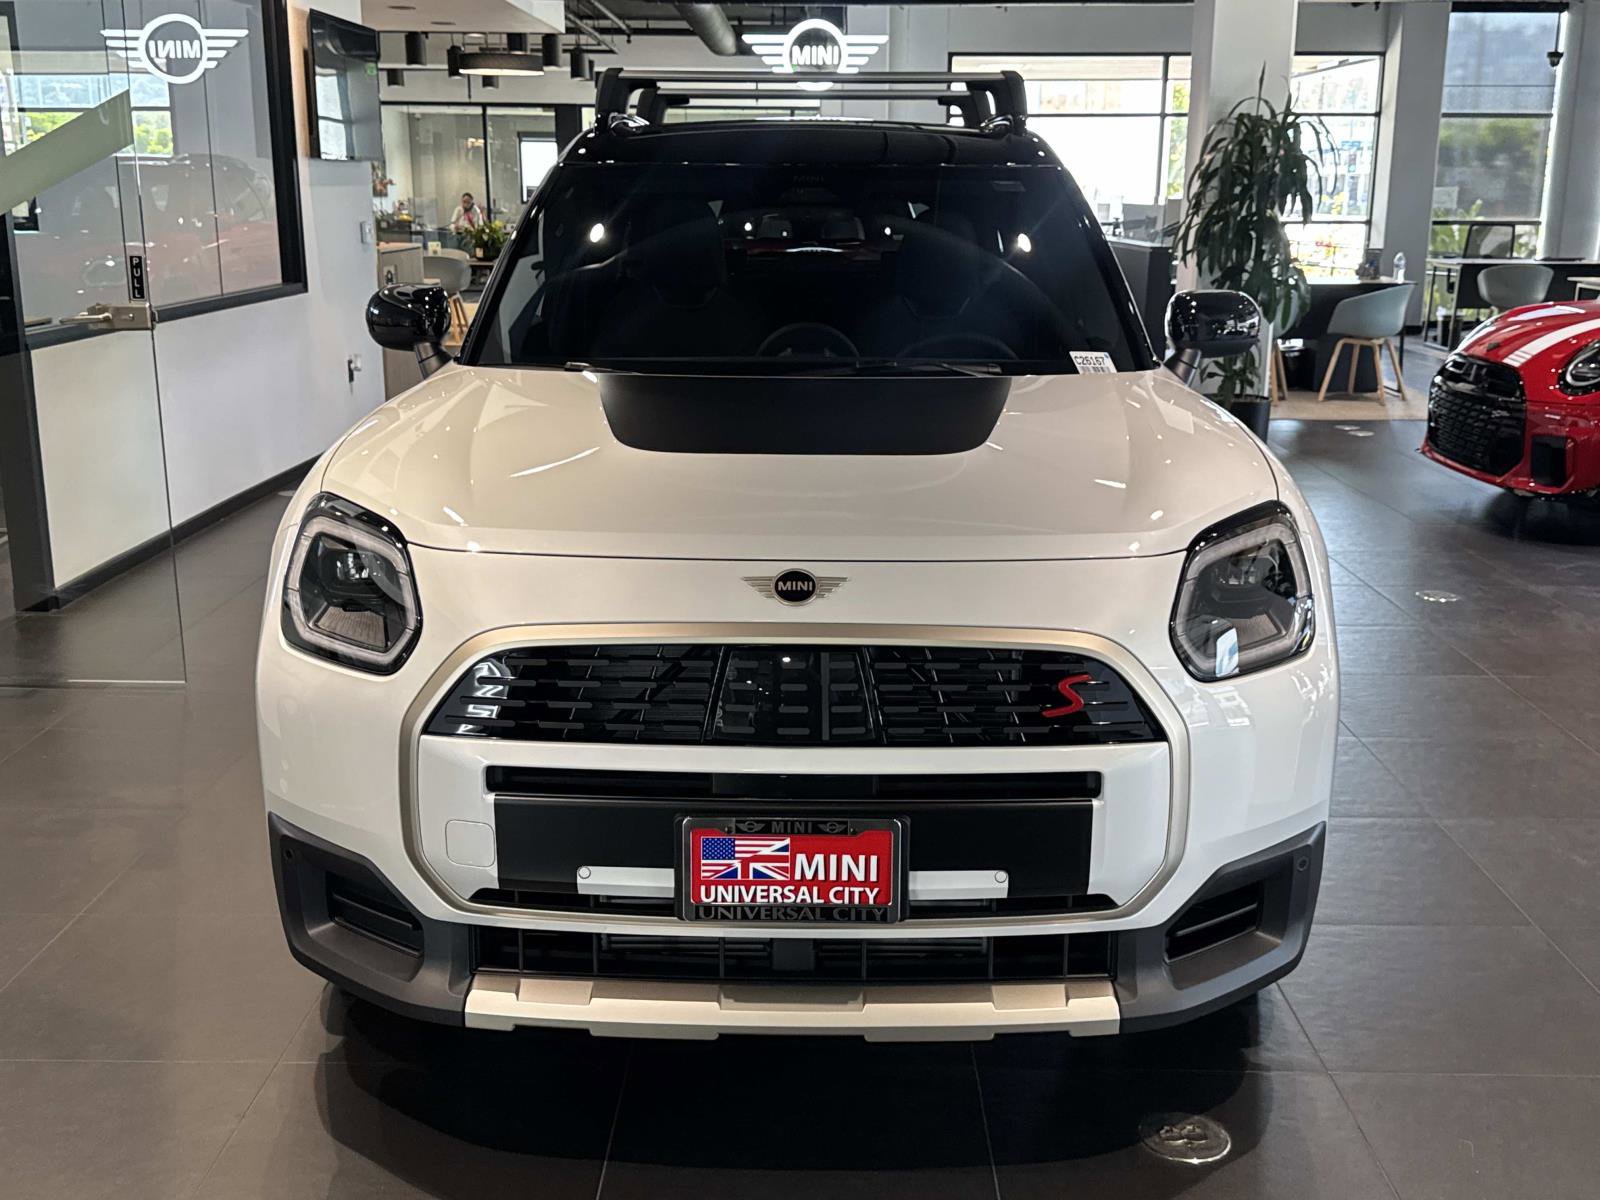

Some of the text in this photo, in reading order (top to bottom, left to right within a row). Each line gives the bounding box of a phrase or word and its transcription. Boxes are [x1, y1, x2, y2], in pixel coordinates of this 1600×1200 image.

[792, 45, 839, 65] MINI
[132, 257, 141, 298] PULL
[777, 581, 813, 591] MINI
[1042, 674, 1091, 718] S
[771, 821, 813, 834] MINI
[794, 853, 878, 882] MINI
[700, 885, 879, 905] UNIVERSAL CITY
[698, 905, 888, 921] UNIVERSAL CITY
